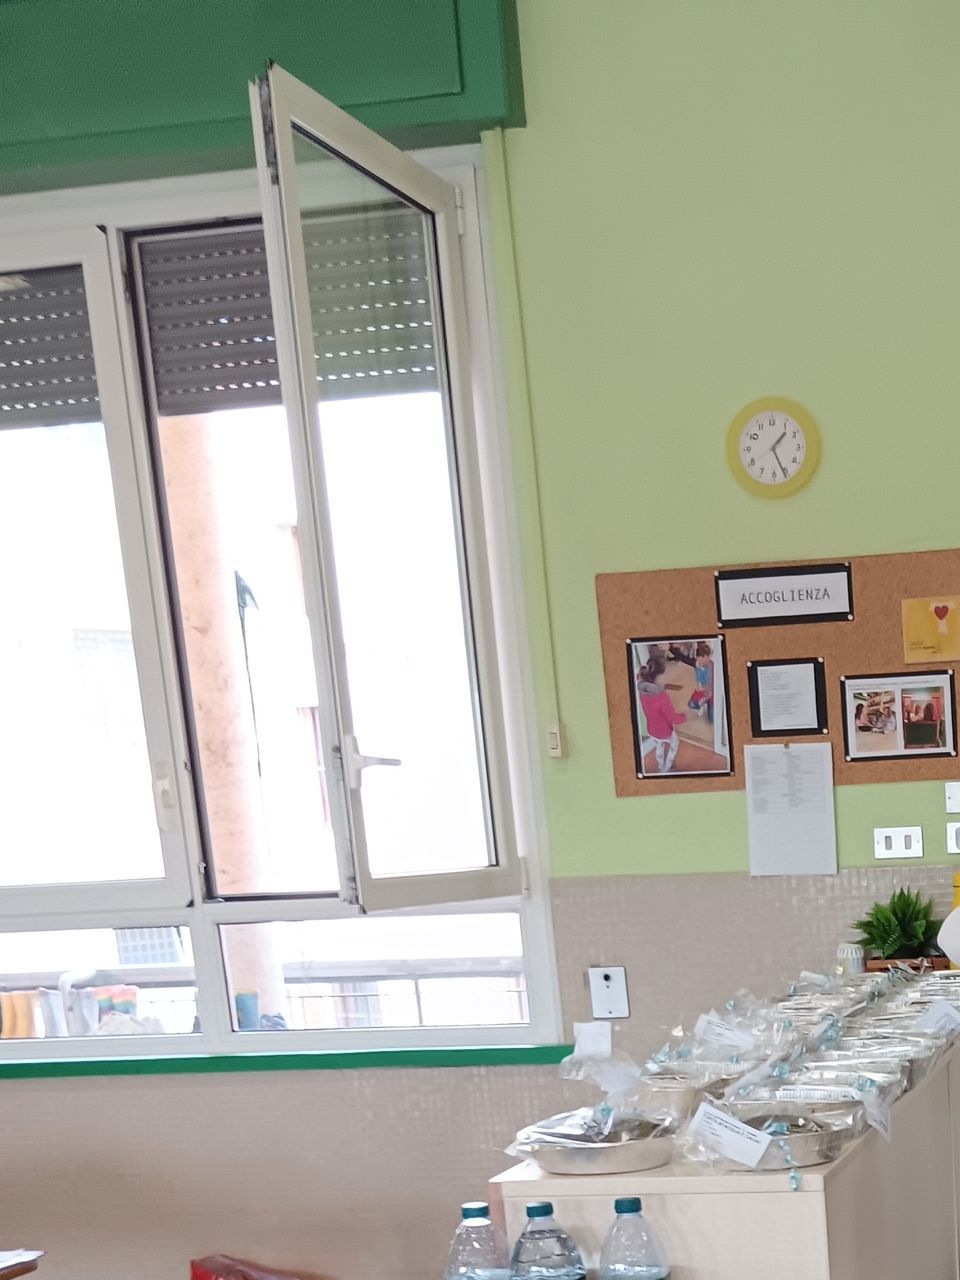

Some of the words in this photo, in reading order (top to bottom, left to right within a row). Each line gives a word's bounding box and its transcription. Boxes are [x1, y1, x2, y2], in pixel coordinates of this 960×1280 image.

[792, 431, 797, 439] 2
[796, 443, 801, 451] 3
[750, 458, 756, 466] 8
[792, 456, 798, 464] 4
[772, 470, 777, 478] 6
[741, 588, 831, 604] ACCOGLIENZA
